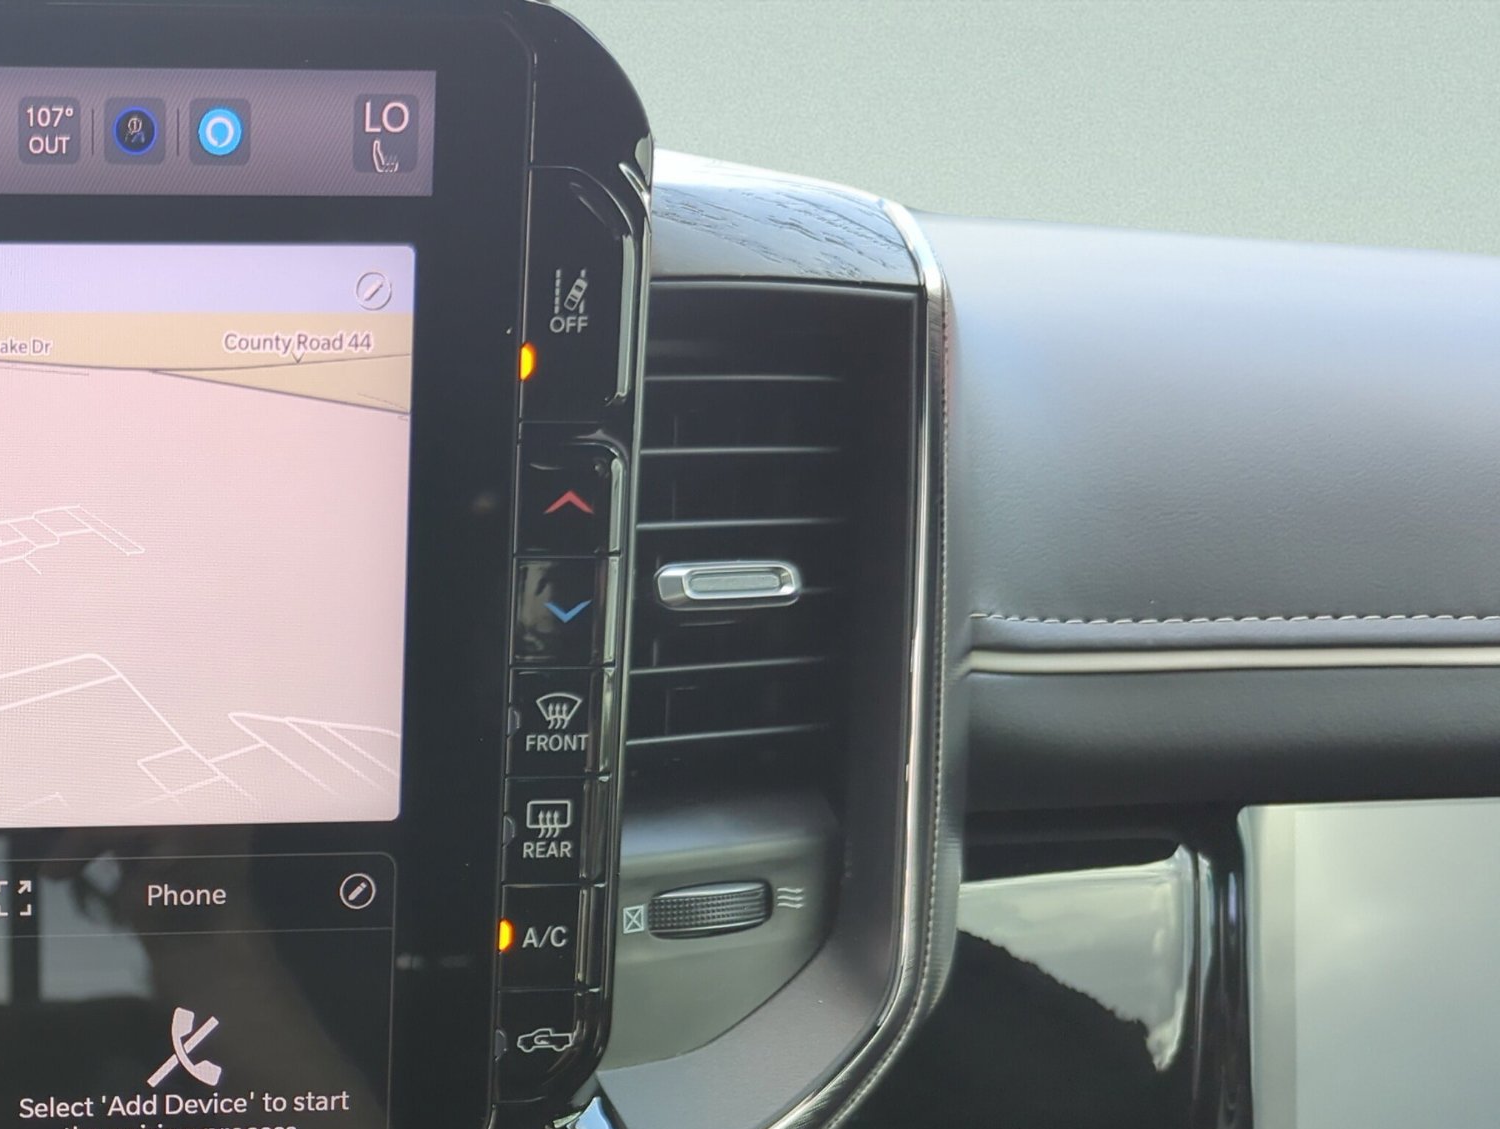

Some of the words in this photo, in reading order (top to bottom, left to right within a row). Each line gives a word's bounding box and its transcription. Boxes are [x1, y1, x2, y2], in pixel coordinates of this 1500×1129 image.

[26, 105, 74, 128] 107°
[364, 100, 410, 134] LO
[29, 136, 71, 155] OUT
[549, 316, 589, 334] OFF
[32, 338, 52, 355] Dr
[223, 334, 291, 355] County
[296, 334, 344, 352] Road
[347, 333, 372, 351] 44
[525, 734, 589, 752] FRONT
[523, 841, 572, 859] REAR
[147, 884, 227, 907] Phone
[522, 926, 569, 948] A/C
[18, 1096, 94, 1119] Select
[101, 1093, 157, 1117] 'Add
[164, 1091, 255, 1116] Device'
[262, 1093, 286, 1113] to
[293, 1091, 350, 1113] start
